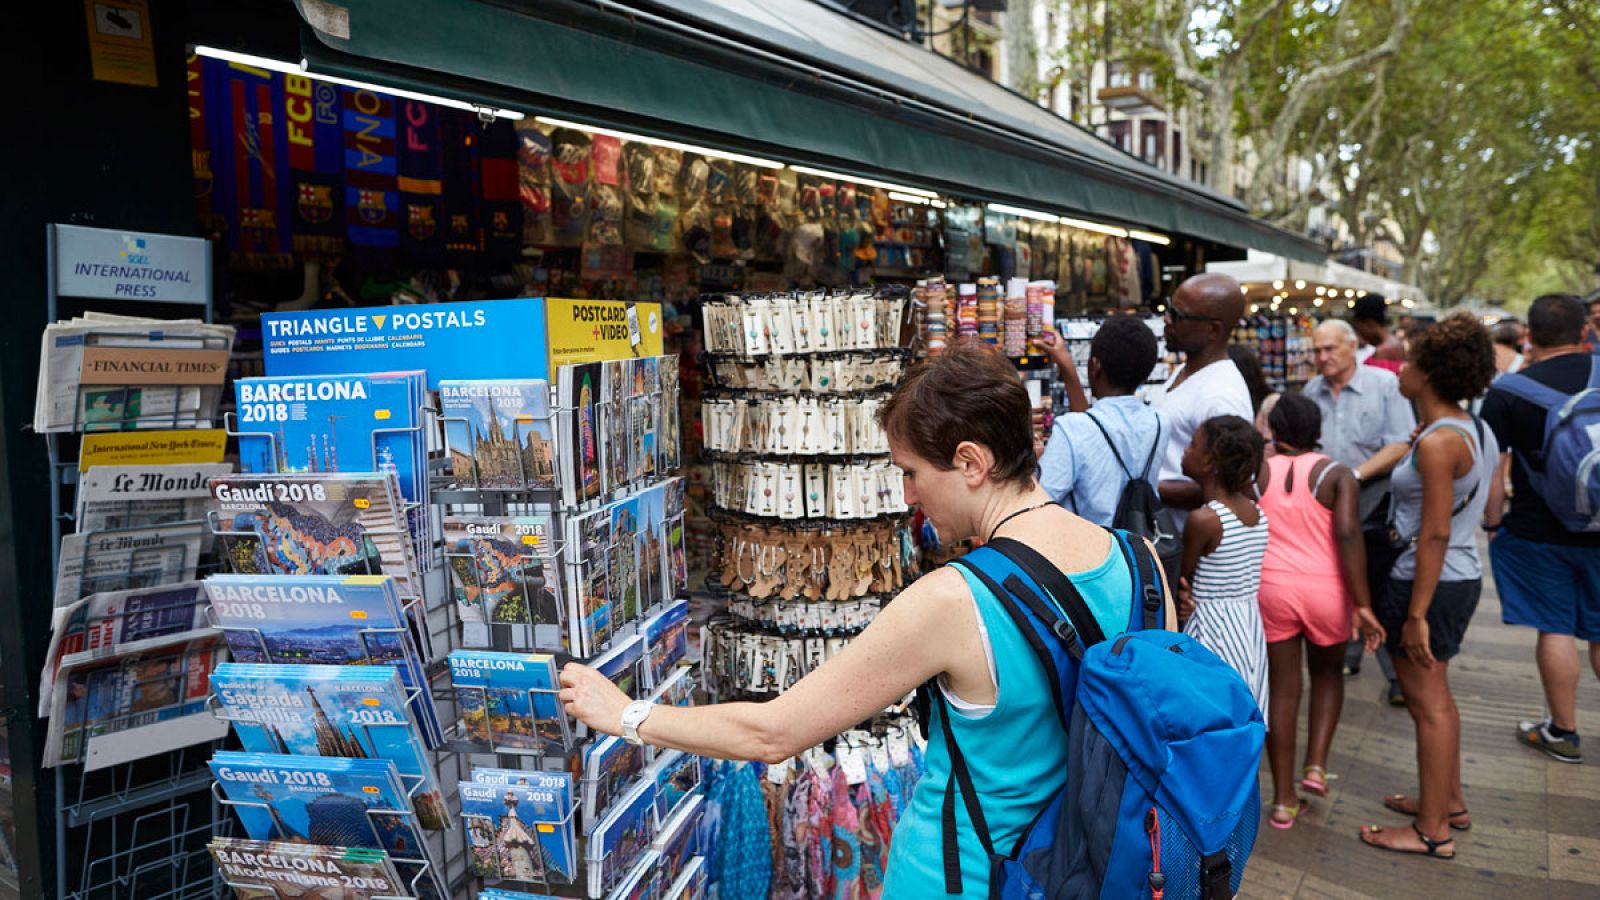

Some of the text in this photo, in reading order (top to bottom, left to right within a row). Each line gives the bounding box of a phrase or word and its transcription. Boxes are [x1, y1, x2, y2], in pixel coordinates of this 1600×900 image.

[74, 263, 192, 283] INTERNATIONAL
[115, 283, 157, 297] PRESS
[572, 305, 626, 322] POSTCARD
[267, 310, 486, 337] TRIANGLE POSTALS
[94, 360, 217, 374] FINANCIAL TIMES
[240, 381, 367, 403] BARCELONA
[442, 386, 522, 398] BARCELONA
[497, 398, 524, 409] 2018
[242, 402, 288, 422] 2018
[93, 439, 216, 454] International New York Times
[109, 472, 134, 492] Le
[276, 483, 326, 502] 2018
[514, 524, 542, 536] 2018
[209, 584, 345, 604] BARCELONA
[220, 604, 266, 620] 2018
[451, 658, 526, 672] BARCELONA
[454, 668, 481, 678] 2018
[221, 690, 305, 710] Sagrada
[347, 710, 397, 724] 2018
[279, 770, 332, 786] 2018
[538, 776, 566, 788] 2018
[526, 791, 554, 802] 2018
[215, 849, 344, 875] BARCELONA
[224, 863, 390, 890] Modernisme 2018
